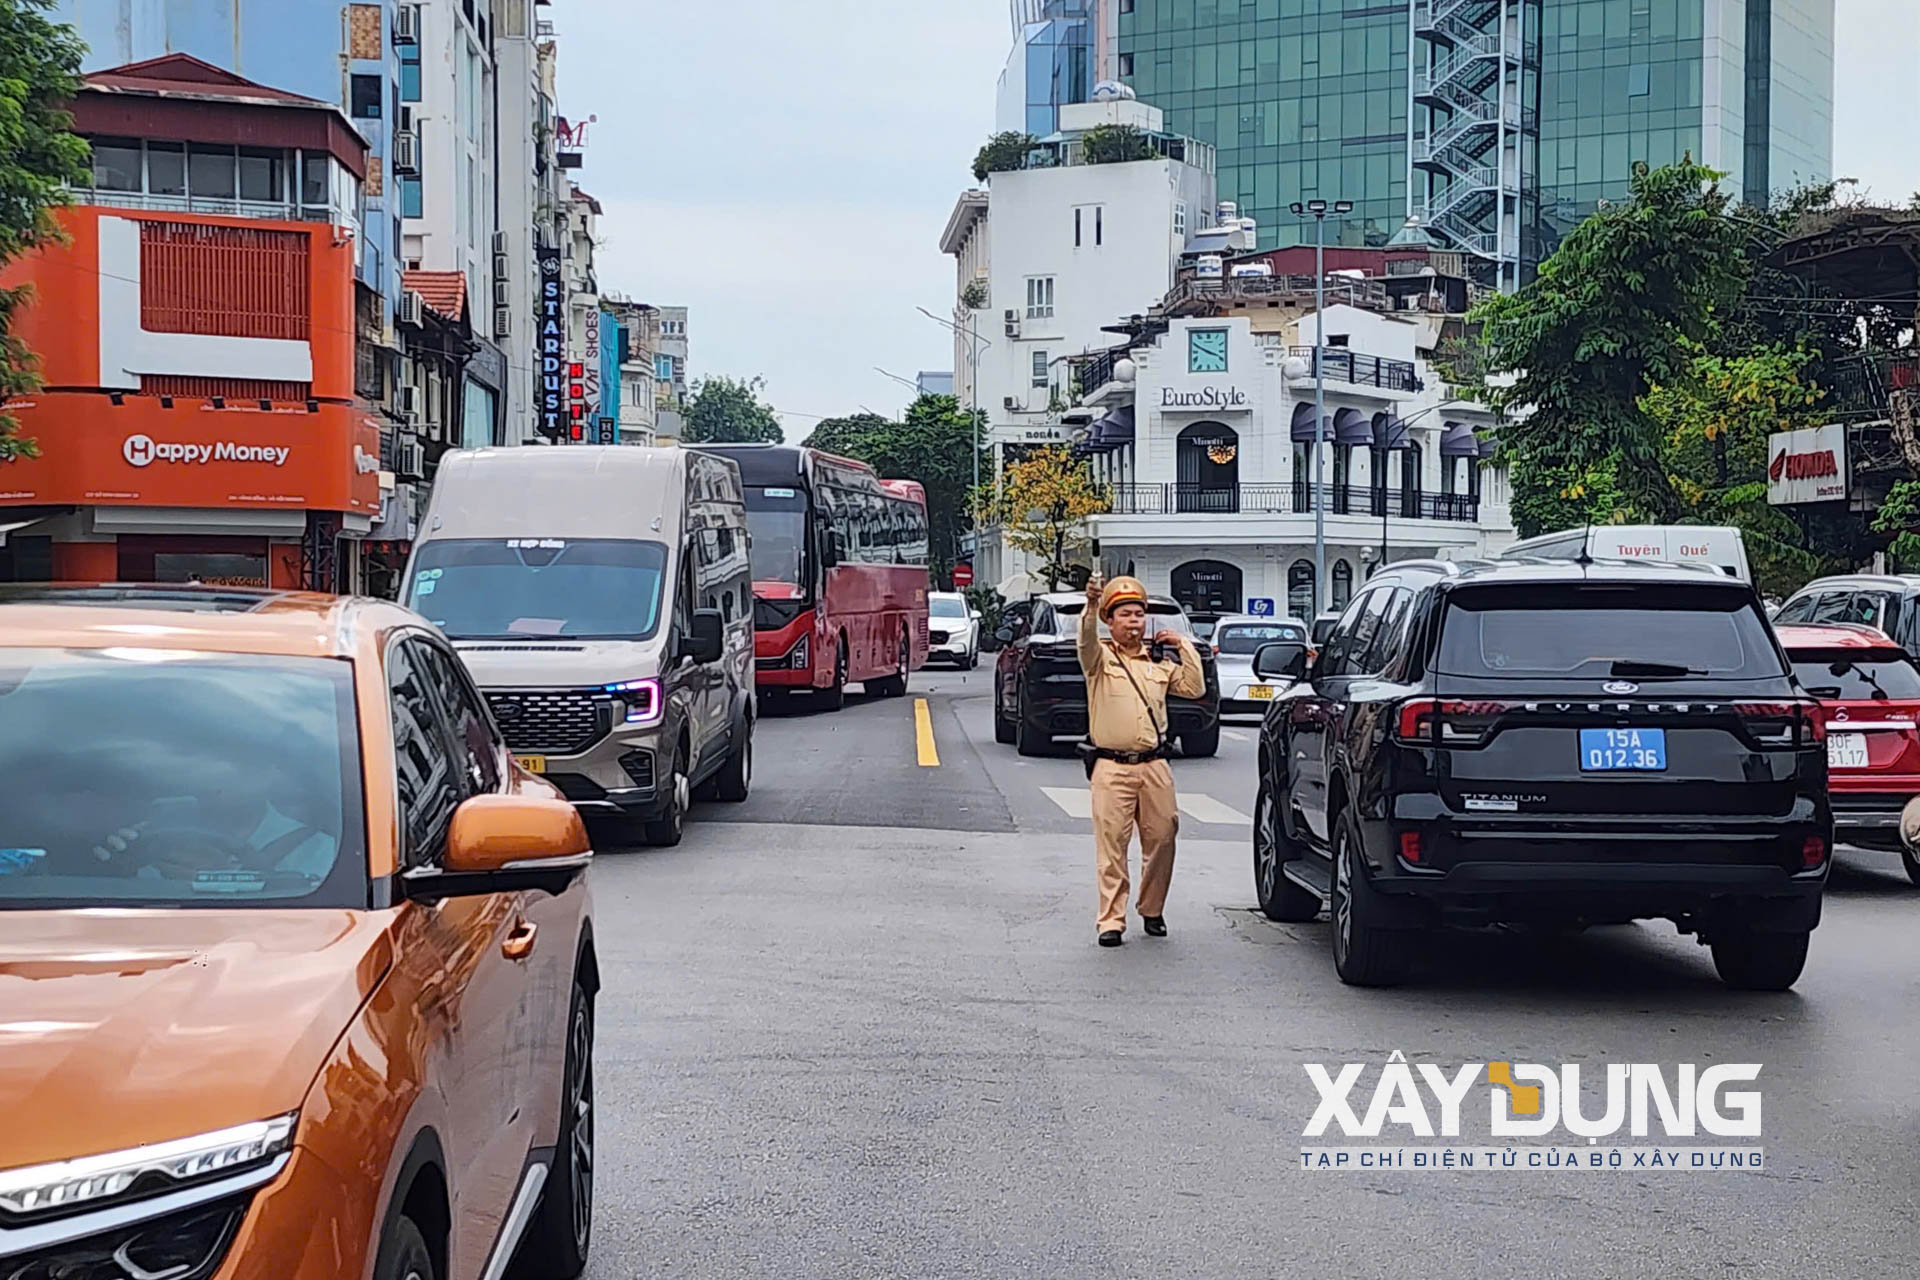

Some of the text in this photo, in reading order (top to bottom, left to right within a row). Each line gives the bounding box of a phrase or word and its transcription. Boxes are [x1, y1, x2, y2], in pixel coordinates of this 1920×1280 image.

[586, 310, 599, 359] SHOES
[543, 282, 560, 428] STARDUST
[1161, 386, 1245, 411] EuroStyle
[124, 434, 290, 466] Happy Money
[1785, 450, 1838, 480] HONDA
[1524, 703, 1719, 713] EVEREST
[1606, 731, 1641, 748] 15A
[1590, 749, 1658, 768] 012.36
[1460, 793, 1547, 803] TITANIUM
